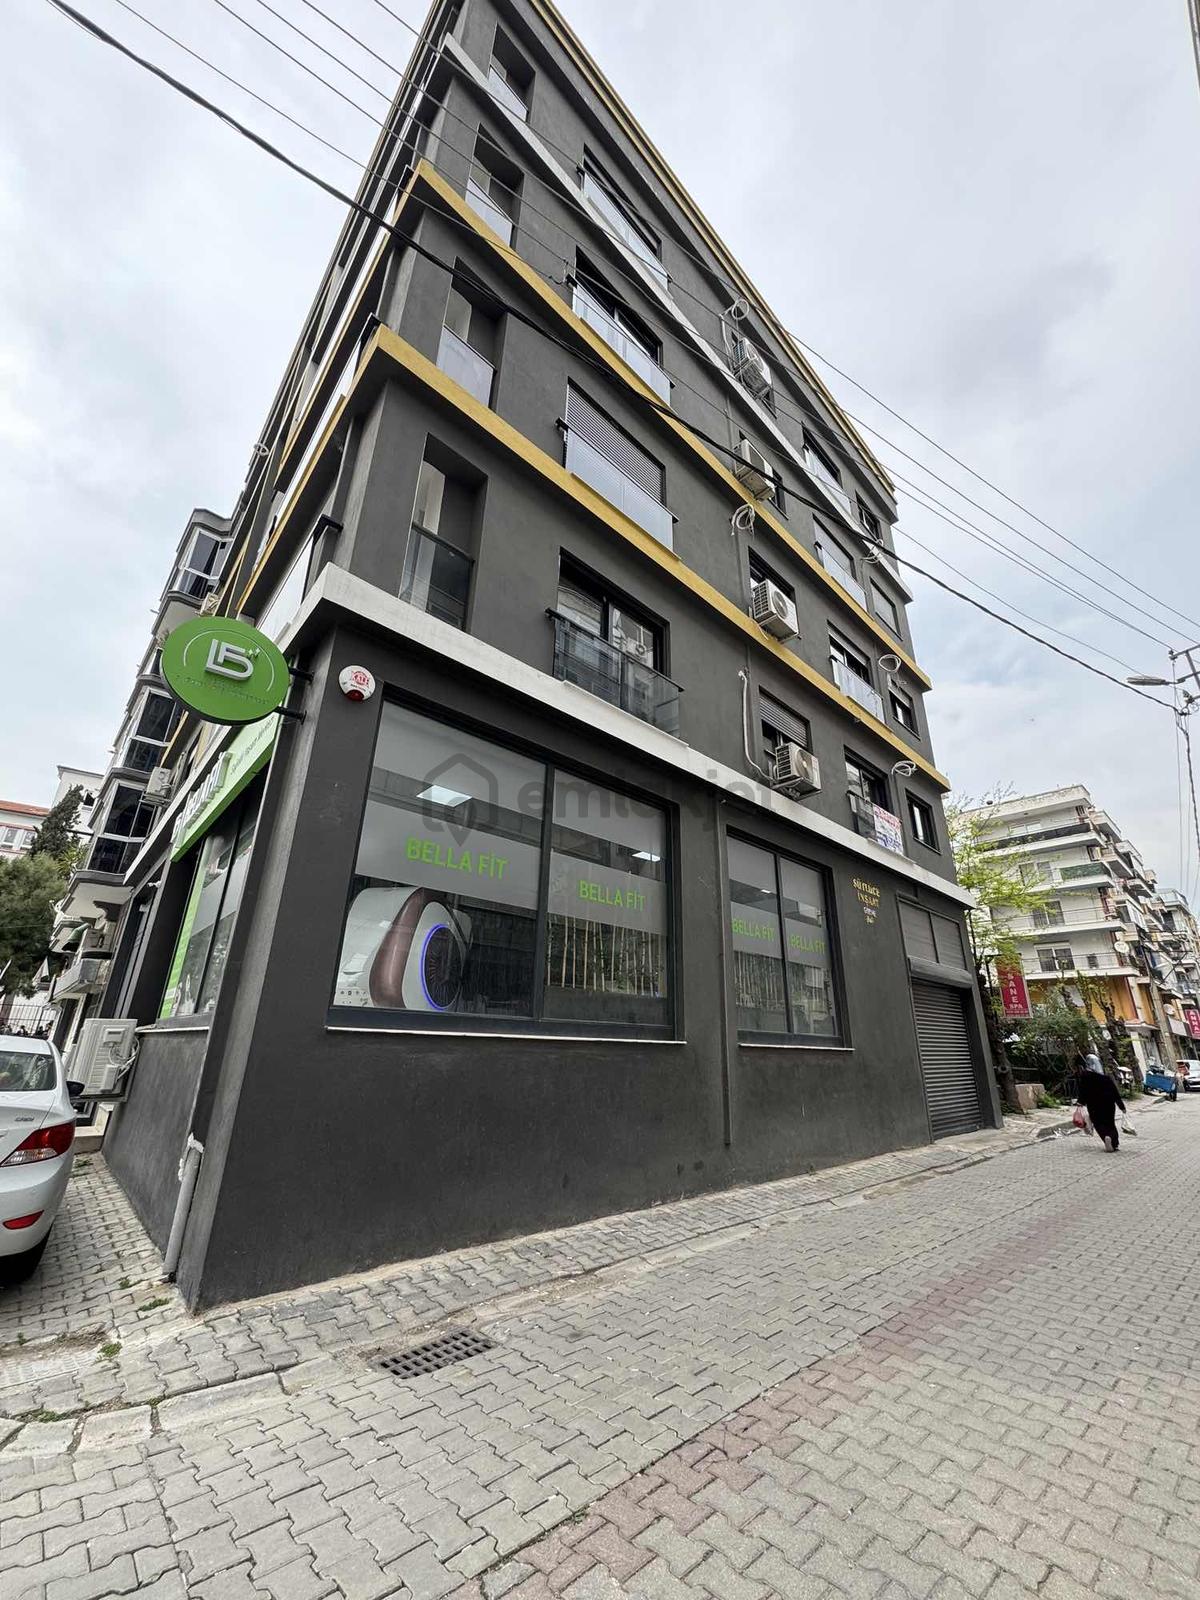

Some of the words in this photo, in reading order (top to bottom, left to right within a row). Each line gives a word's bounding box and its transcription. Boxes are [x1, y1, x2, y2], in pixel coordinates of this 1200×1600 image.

[404, 836, 472, 873] BELLA
[477, 849, 508, 879] FİT
[578, 879, 623, 907] BELLA
[732, 918, 761, 939] BELLA
[790, 935, 814, 953] BELLA
